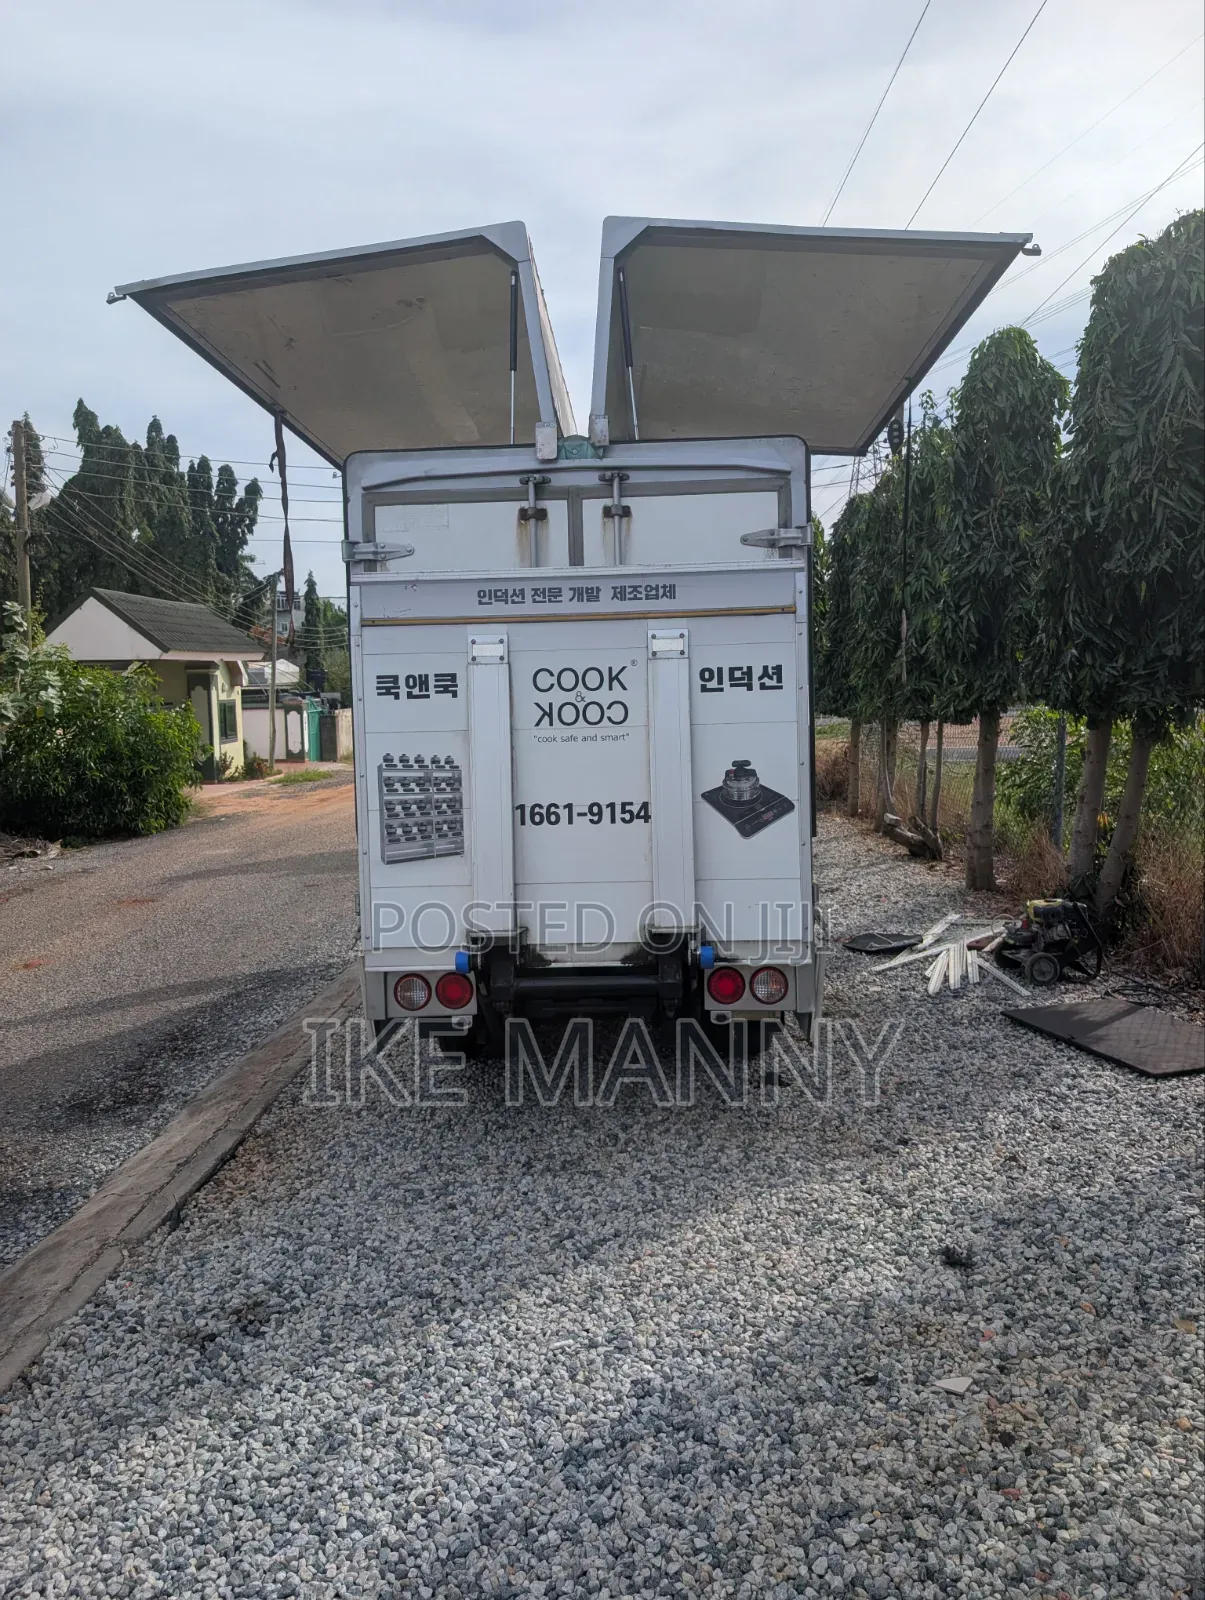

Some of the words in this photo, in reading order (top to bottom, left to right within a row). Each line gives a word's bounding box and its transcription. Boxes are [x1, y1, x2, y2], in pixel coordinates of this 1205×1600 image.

[477, 587, 526, 606] 인덕션
[531, 586, 563, 604] 전문
[568, 586, 601, 603] 개발
[611, 583, 677, 601] 제조업체
[376, 673, 458, 700] 쿡앤쿡
[532, 666, 628, 693] COOK
[699, 664, 783, 693] 인덕션
[575, 690, 586, 703] &
[560, 734, 578, 743] safe
[581, 734, 597, 742] and
[515, 801, 651, 826] 1661-9154
